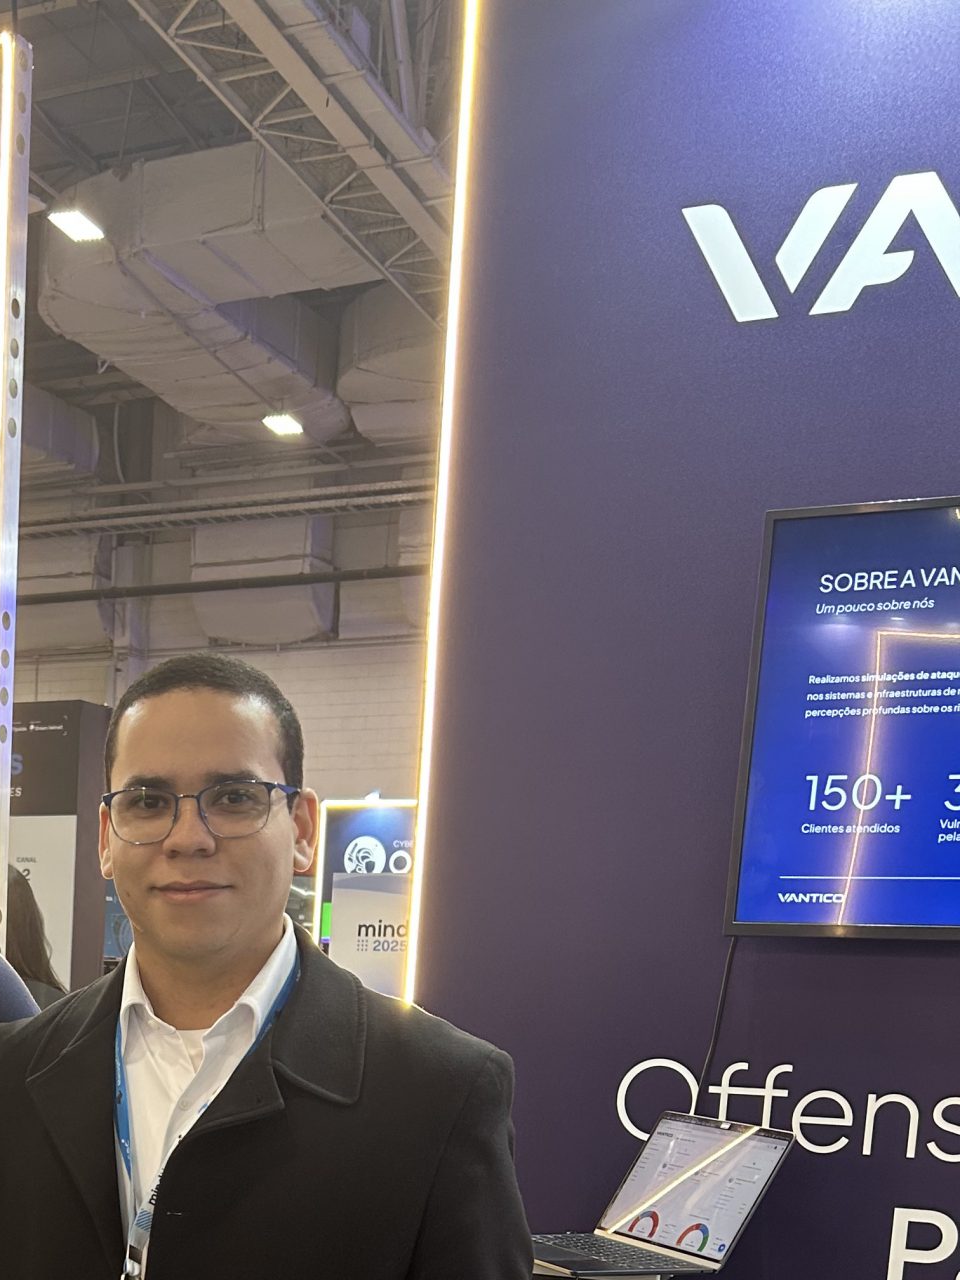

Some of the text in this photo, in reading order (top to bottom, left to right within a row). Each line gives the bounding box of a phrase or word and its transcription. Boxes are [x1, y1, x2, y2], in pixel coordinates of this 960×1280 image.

[819, 570, 898, 593] SOBRE
[900, 569, 916, 588] A
[816, 597, 935, 615] Um pouco sobre nós
[808, 674, 860, 684] Realizamos
[861, 671, 915, 683] simulações
[916, 671, 929, 680] de
[806, 693, 823, 701] nos
[825, 691, 865, 700] sistemas
[874, 688, 942, 699] nfraestruturas
[943, 687, 957, 696] de
[805, 706, 861, 719] percepções
[862, 704, 910, 717] profundas
[911, 704, 940, 714] sobre
[940, 705, 953, 713] os
[806, 773, 912, 811] 150+
[801, 823, 845, 834] Clientes
[846, 823, 900, 834] atendidos
[778, 893, 845, 903] VANTICO
[373, 940, 407, 952] 2025
